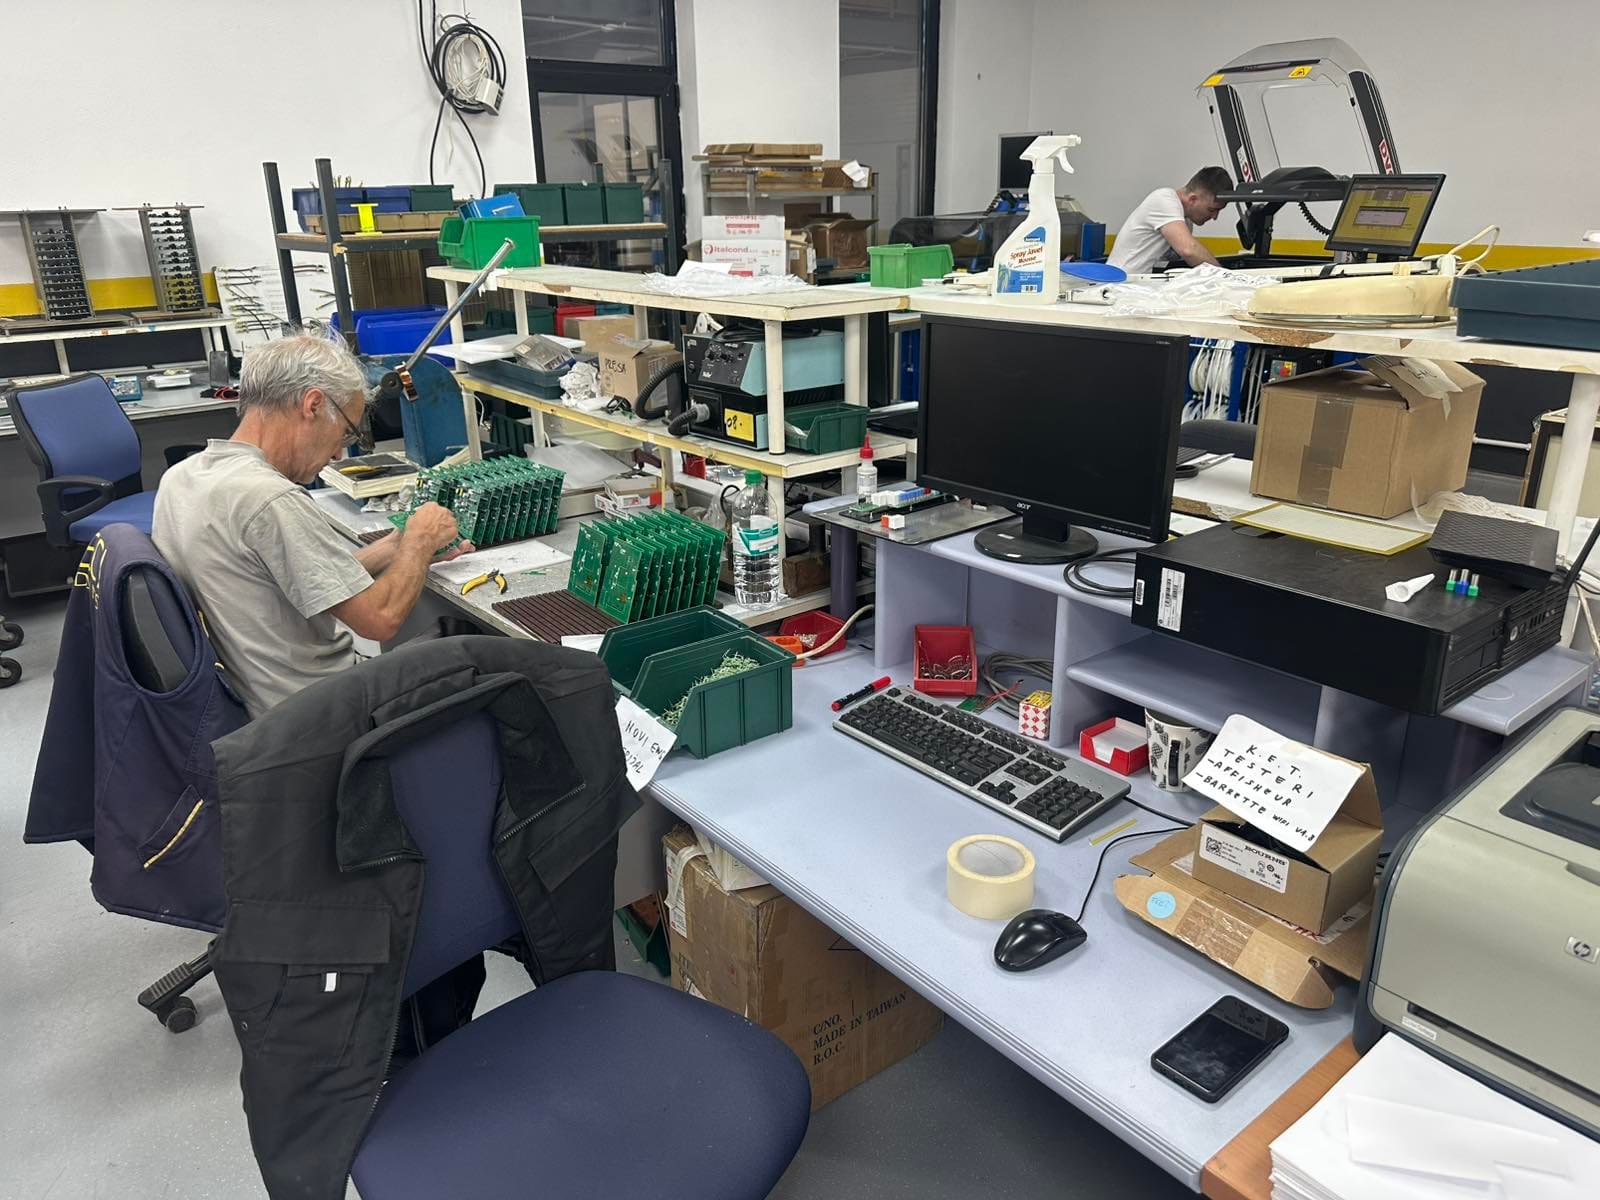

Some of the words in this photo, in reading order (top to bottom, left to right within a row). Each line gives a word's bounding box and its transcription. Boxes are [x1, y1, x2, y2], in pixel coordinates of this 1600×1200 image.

[813, 1025, 847, 1051] MADE
[850, 1015, 863, 1031] IN
[866, 990, 907, 1021] TAIWAN
